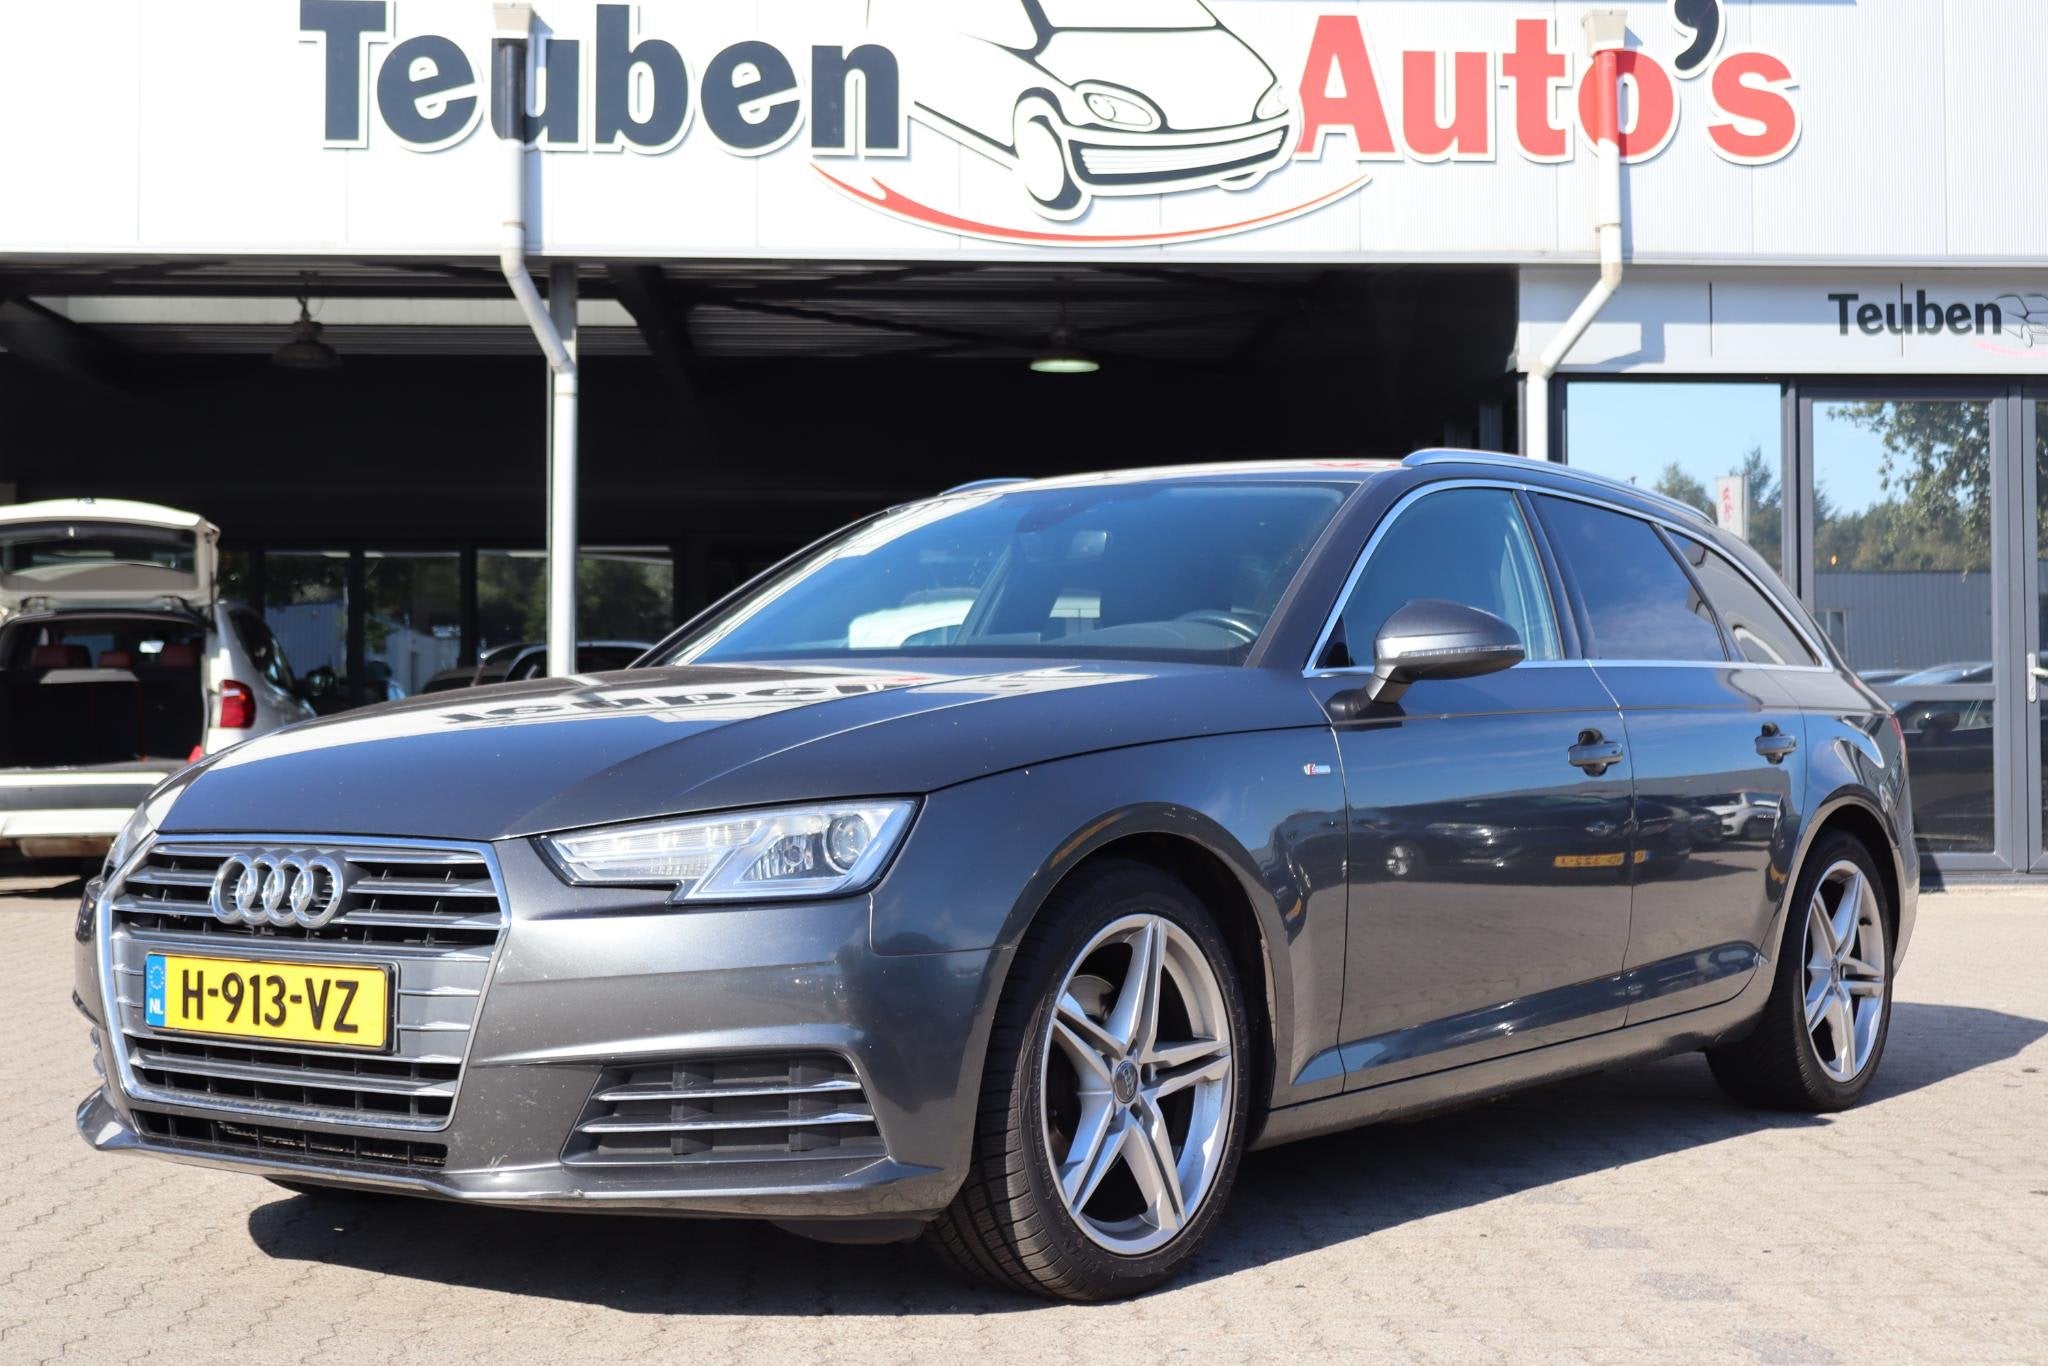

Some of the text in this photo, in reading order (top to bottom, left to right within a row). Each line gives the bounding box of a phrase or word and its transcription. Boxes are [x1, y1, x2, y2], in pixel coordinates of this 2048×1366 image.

[299, 0, 1801, 159] Teuben Auto's
[1827, 289, 2002, 336] Teuben
[149, 998, 164, 1015] NL
[182, 969, 359, 1034] H-913-VZ
